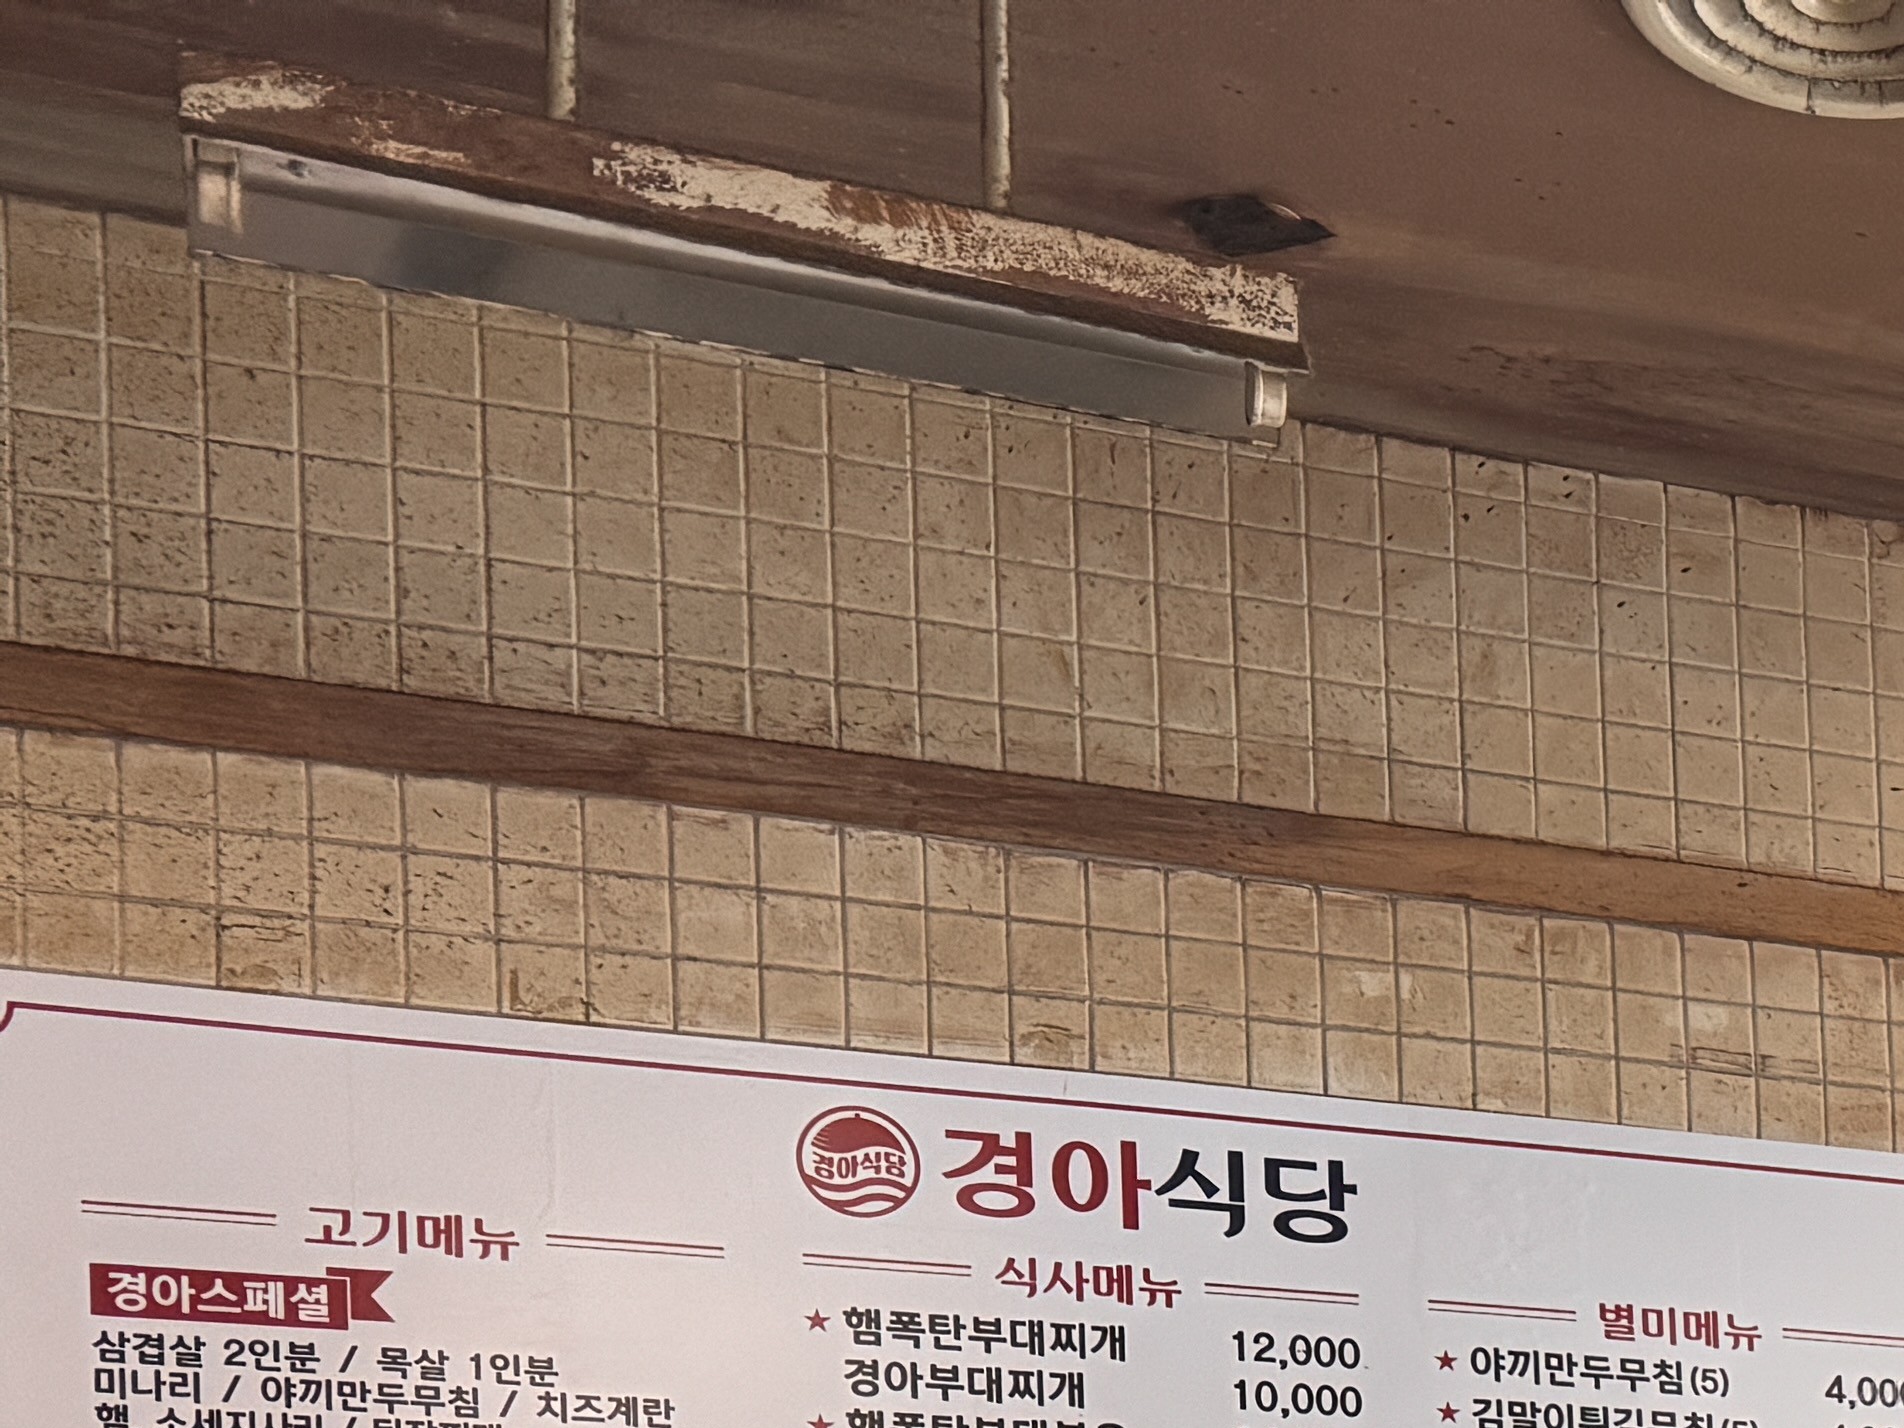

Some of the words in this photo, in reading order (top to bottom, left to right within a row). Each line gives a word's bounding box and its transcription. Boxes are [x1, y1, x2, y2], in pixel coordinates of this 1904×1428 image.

[811, 1146, 908, 1181] 경아식당
[942, 1129, 1357, 1243] 경아식당
[305, 1207, 519, 1261] 고기메뉴
[108, 1272, 329, 1322] 경아스페셜
[995, 1258, 1182, 1308] 식사메뉴
[843, 1307, 1125, 1362] 햄폭탄부대찌개
[1232, 1331, 1360, 1370] 12,000
[1599, 1303, 1762, 1351] 별미메뉴
[92, 1331, 206, 1368] 삼겹살
[224, 1339, 320, 1374] 2인분
[377, 1347, 449, 1382] 목살
[470, 1353, 559, 1387] 1인분
[845, 1359, 1084, 1409] 경아부대찌개
[95, 1368, 200, 1404] 미나리
[261, 1377, 479, 1418] 야끼만두무침
[537, 1391, 675, 1428] 치즈계란
